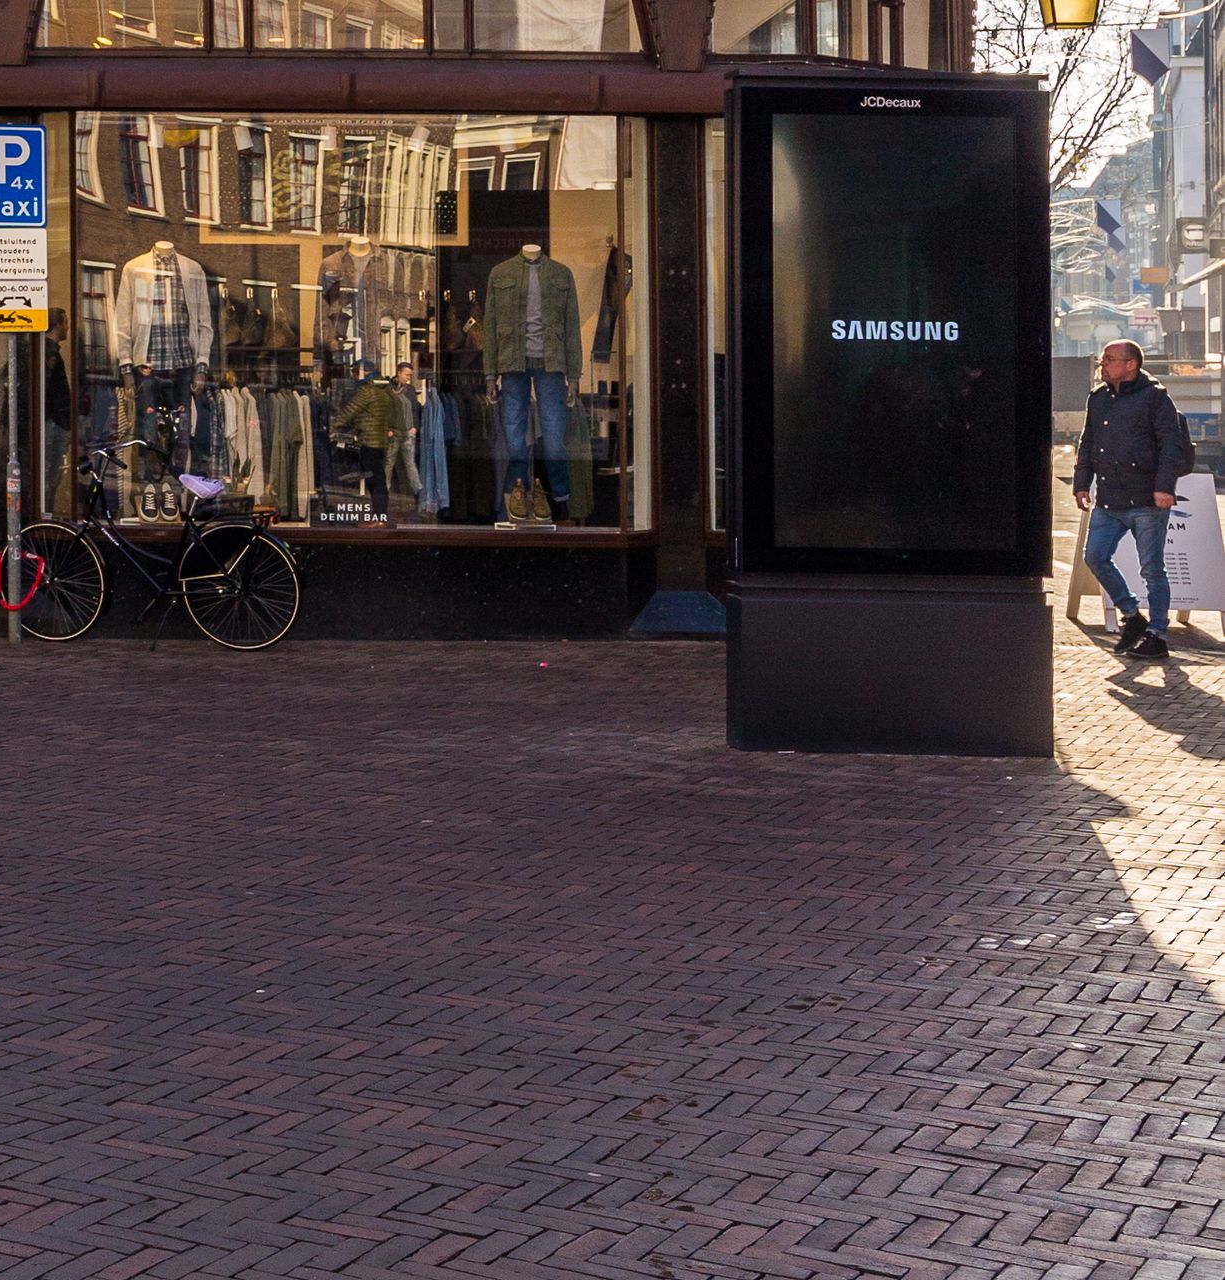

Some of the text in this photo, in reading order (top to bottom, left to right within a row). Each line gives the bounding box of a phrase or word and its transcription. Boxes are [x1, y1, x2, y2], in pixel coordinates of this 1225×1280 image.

[860, 96, 921, 108] JCDecaux
[10, 175, 34, 190] 4x
[831, 319, 959, 342] SAMSUNG
[337, 503, 371, 512] MENS
[320, 513, 388, 522] DENIM BAR
